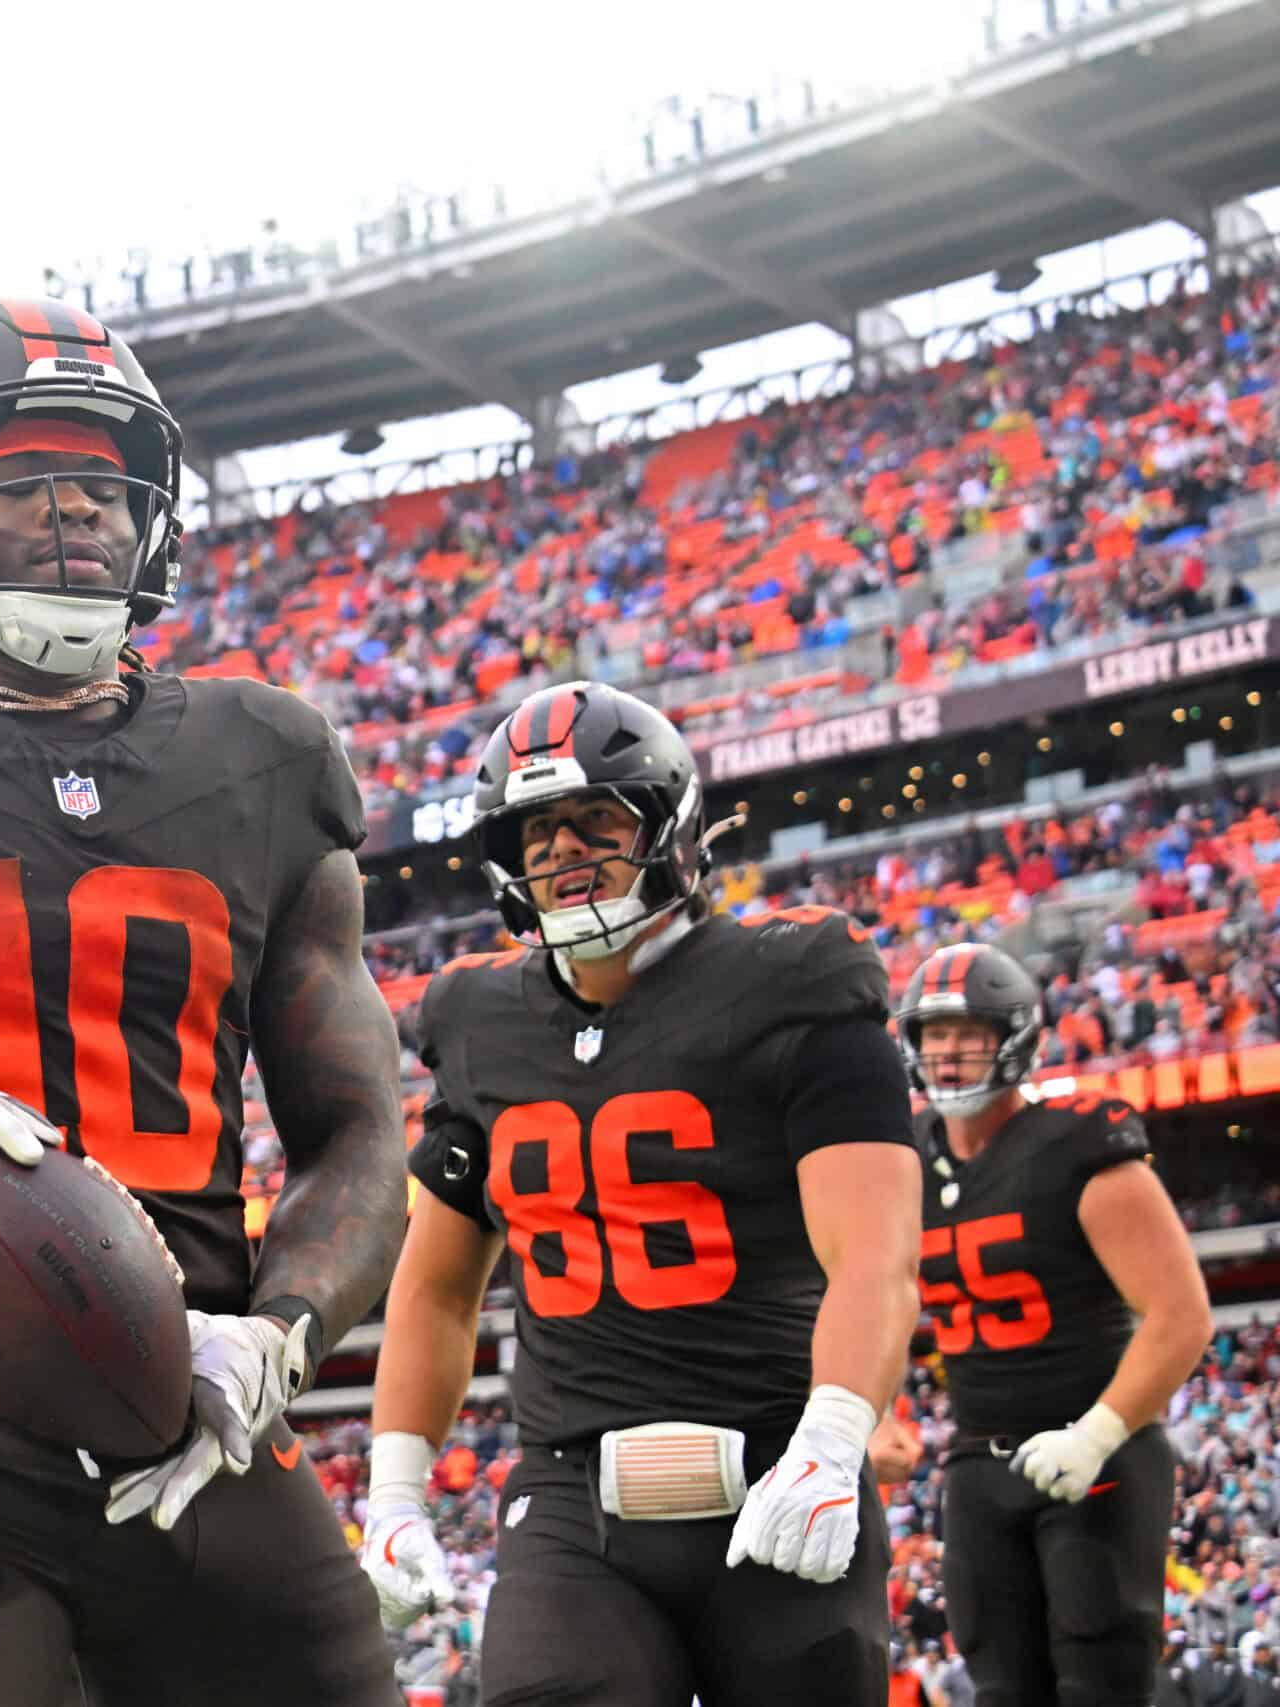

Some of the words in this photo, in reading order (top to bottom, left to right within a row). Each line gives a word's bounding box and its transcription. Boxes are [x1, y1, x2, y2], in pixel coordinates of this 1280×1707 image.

[1084, 641, 1173, 698] LEROY
[1177, 618, 1269, 676] KELLY
[64, 792, 94, 810] NFL
[488, 1089, 737, 1318] 86
[917, 1211, 1054, 1355] 55
